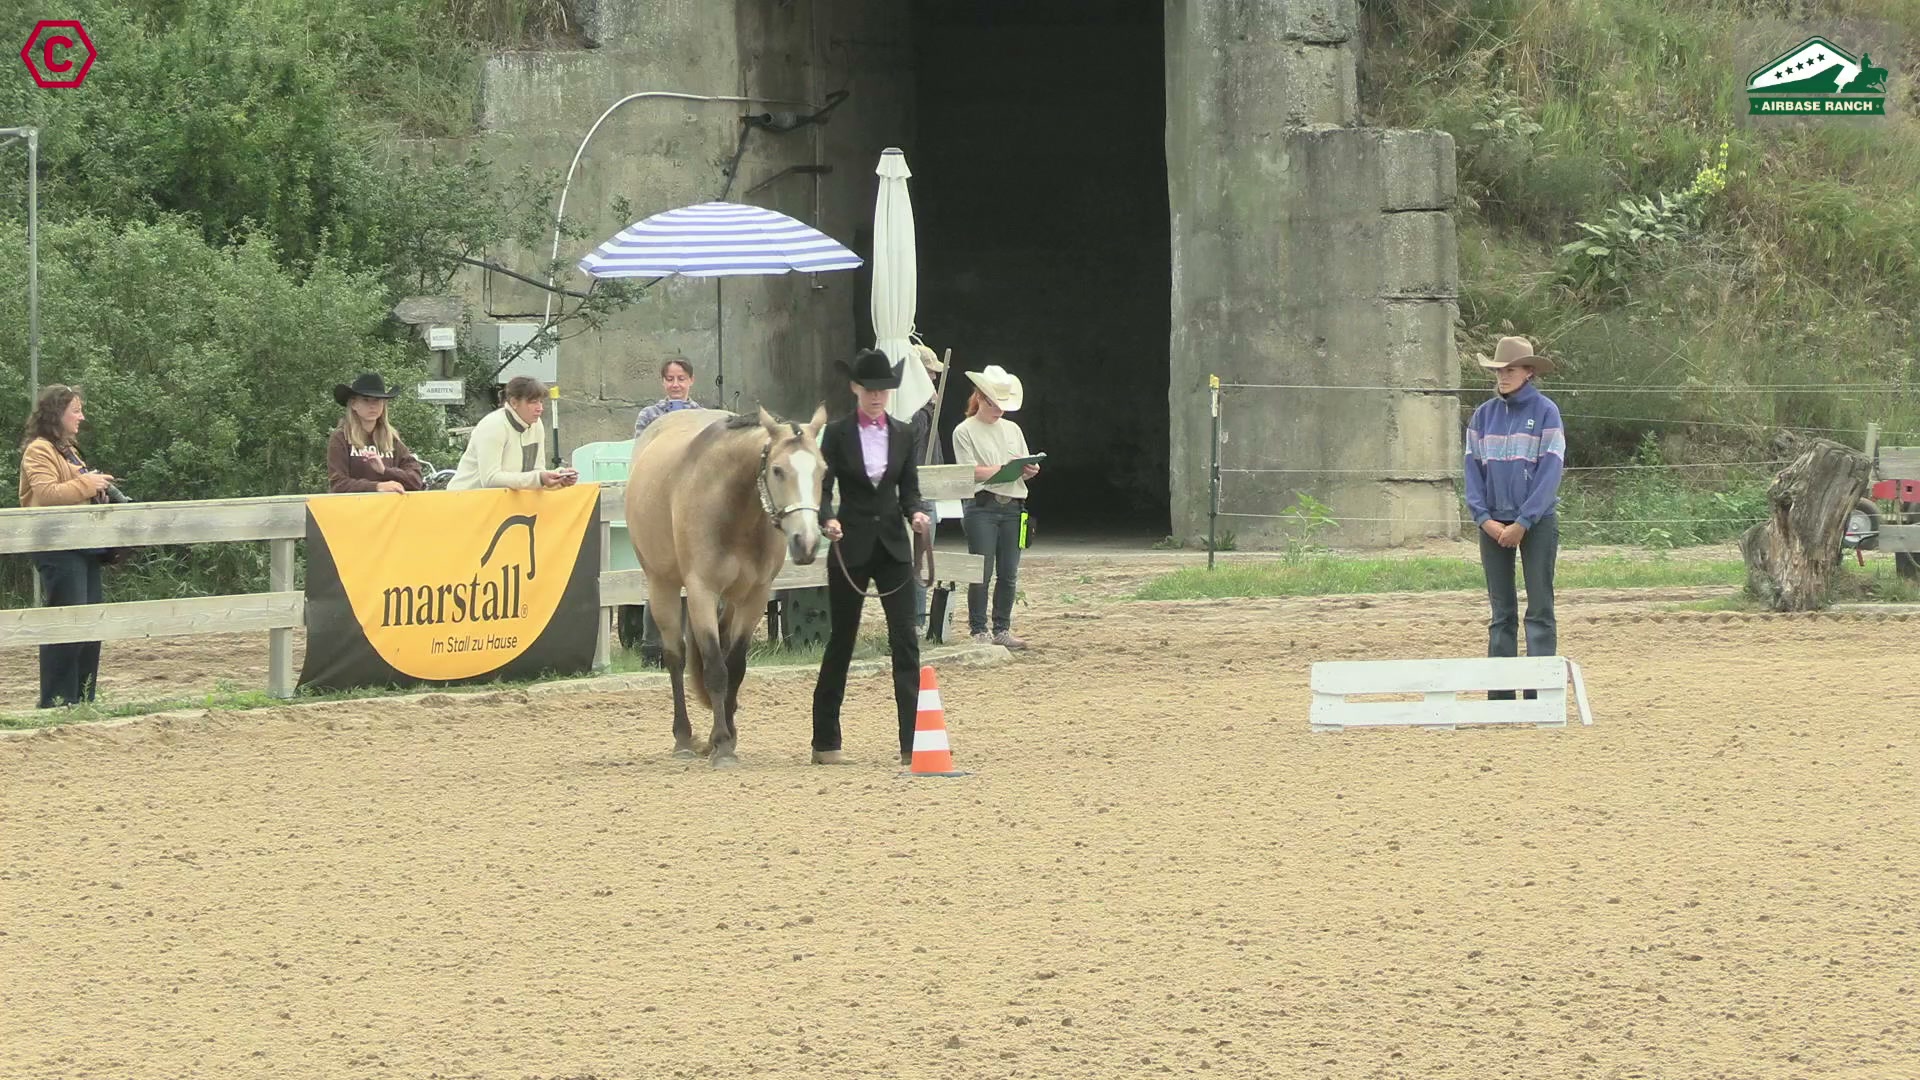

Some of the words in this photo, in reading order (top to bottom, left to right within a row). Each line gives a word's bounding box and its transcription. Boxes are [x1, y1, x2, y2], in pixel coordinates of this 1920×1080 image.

[431, 638, 444, 654] Im
[447, 635, 470, 653] Stall
[471, 638, 484, 652] zu
[486, 634, 518, 650] Hause
